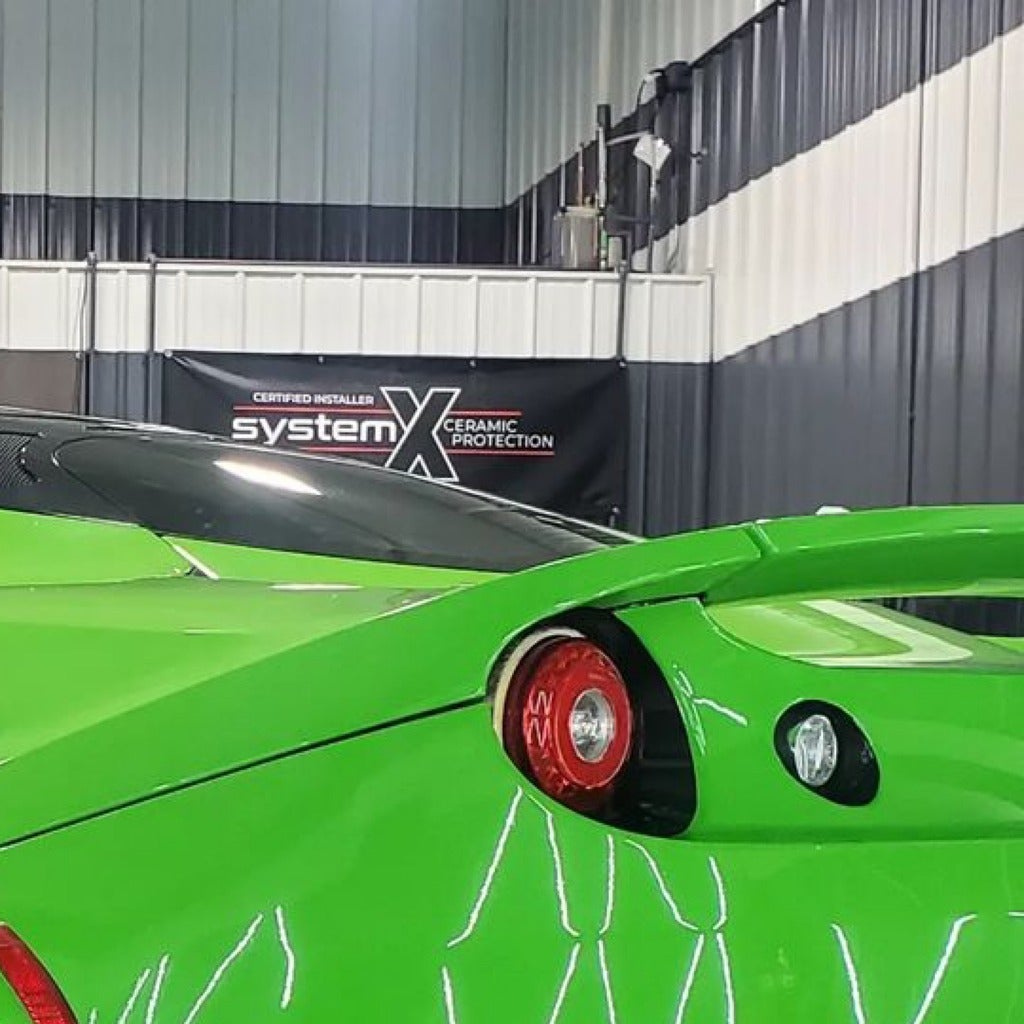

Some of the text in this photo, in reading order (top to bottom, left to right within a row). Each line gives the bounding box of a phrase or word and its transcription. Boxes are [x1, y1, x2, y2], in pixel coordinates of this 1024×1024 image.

[253, 391, 375, 406] CERTIFIED INSTALLER
[443, 418, 518, 433] CERAMIC
[451, 434, 555, 449] PROTECTION
